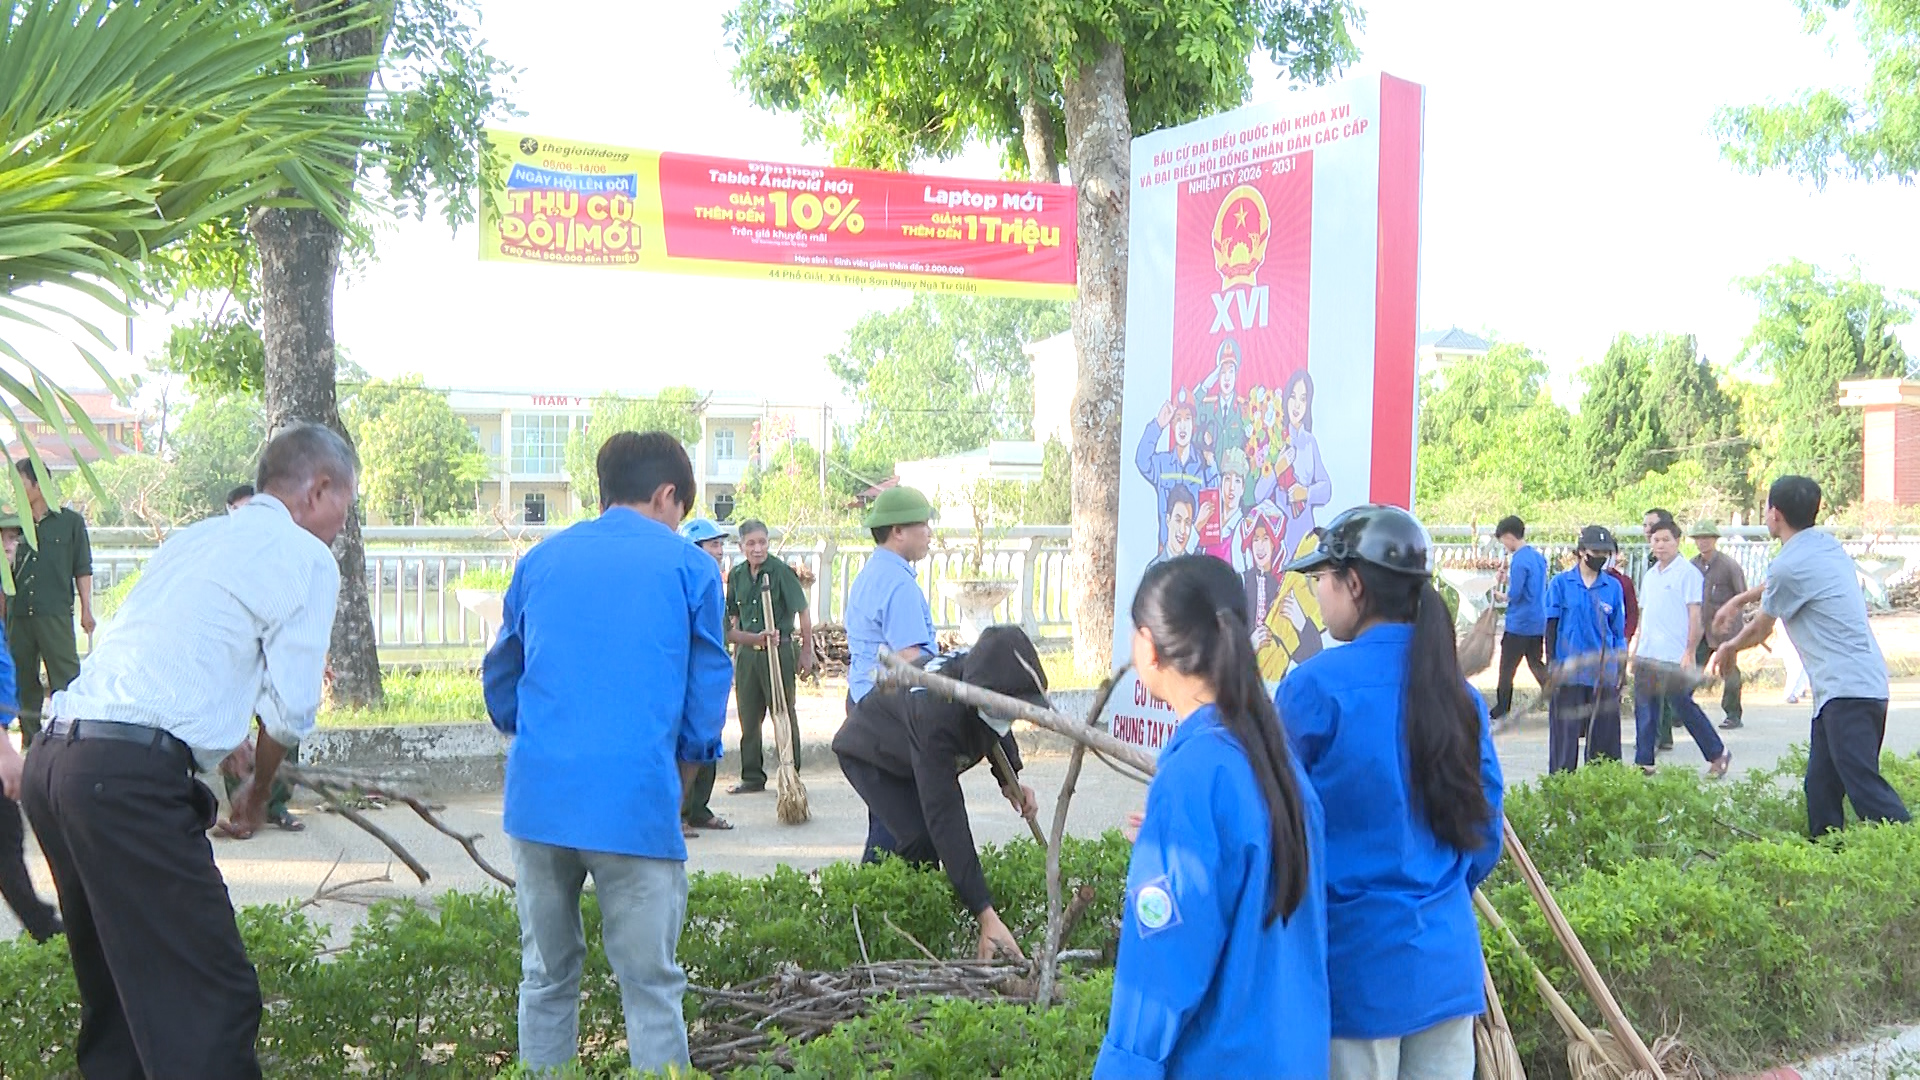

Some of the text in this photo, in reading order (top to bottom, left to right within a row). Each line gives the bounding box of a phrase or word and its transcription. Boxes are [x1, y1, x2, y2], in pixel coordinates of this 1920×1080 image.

[1192, 141, 1209, 157] ĐẠI
[1212, 130, 1236, 152] BIỂU
[1240, 122, 1269, 145] QUỐC
[1272, 118, 1291, 137] HỘI
[1331, 104, 1350, 121] XVI
[1140, 171, 1152, 188] VÀ
[1154, 169, 1171, 186] ĐẠI
[1199, 156, 1217, 174] HỘI
[1219, 149, 1249, 168] ĐỒNG
[1252, 140, 1284, 160] NHÂN
[1287, 133, 1311, 152] DÂN
[1315, 126, 1339, 144] CÁC
[1343, 115, 1369, 138] CẤP
[515, 168, 551, 188] NGÀY
[554, 174, 577, 191] HỘI
[580, 174, 603, 190] LÊN
[709, 169, 757, 186] Tablet
[759, 173, 821, 192] Android
[1188, 174, 1220, 195] NHIỆM
[1237, 165, 1262, 184] 2026
[1272, 157, 1296, 176] 2031
[509, 190, 633, 221] THU CŨ
[729, 191, 765, 206] GIẢM
[923, 185, 998, 212] Laptop
[694, 206, 765, 224] THÊM ĐẾN
[768, 191, 865, 234] 10%
[931, 211, 962, 227] GIẢM
[575, 219, 641, 250] MỚI
[731, 226, 753, 237] Trên
[755, 227, 771, 241] giá
[772, 229, 807, 242] khuyến
[901, 224, 962, 240] THÊM ĐẾN
[769, 269, 780, 278] 44
[794, 255, 810, 264] Học
[811, 255, 828, 264] sinh
[834, 257, 851, 266] Sinh
[852, 258, 868, 267] viên
[889, 261, 908, 270] thêm
[925, 263, 965, 275] 2.000.000
[1209, 285, 1270, 335] XVI
[1113, 714, 1145, 746] CHUNG
[1147, 719, 1164, 749] TAY
